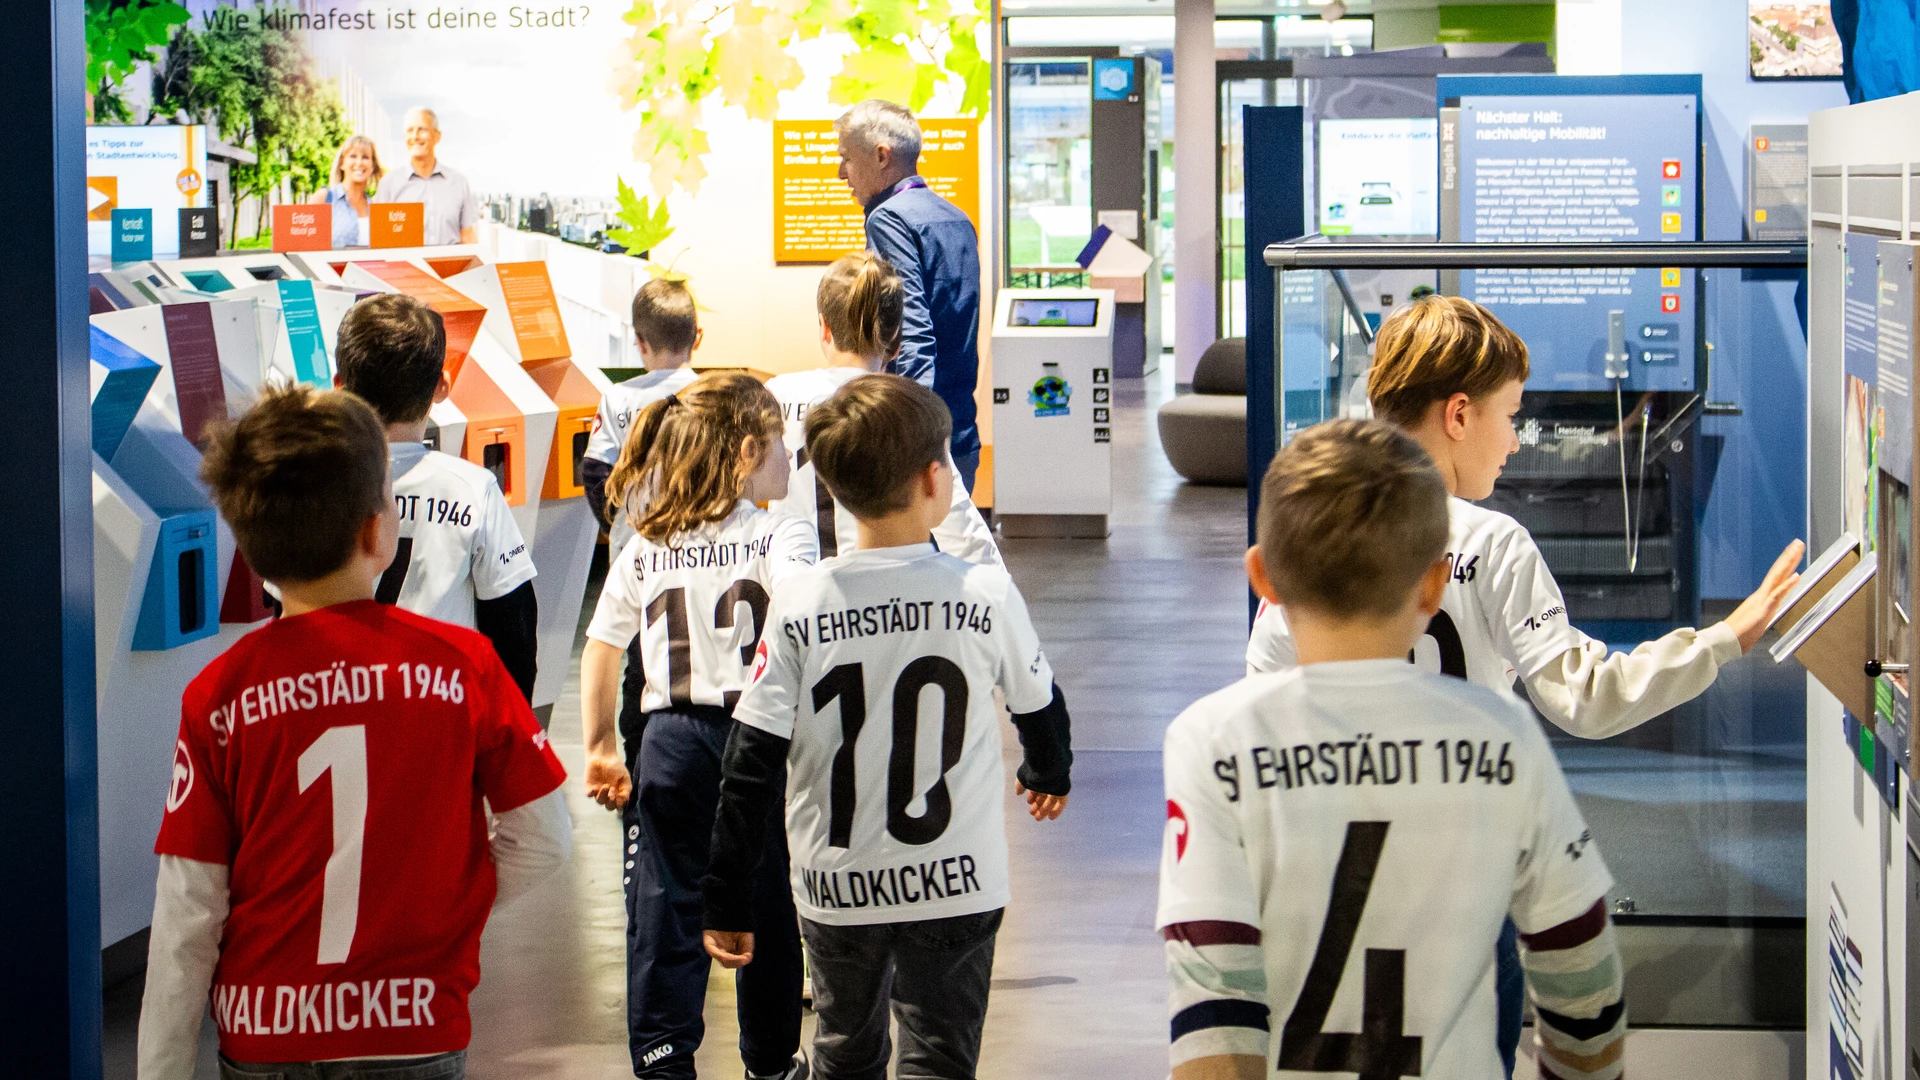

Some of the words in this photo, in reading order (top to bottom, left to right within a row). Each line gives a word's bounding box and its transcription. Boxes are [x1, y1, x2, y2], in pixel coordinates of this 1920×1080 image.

[202, 9, 249, 31] Wie
[260, 7, 376, 31] klimafest
[386, 8, 417, 29] ist
[427, 7, 497, 28] deine
[509, 5, 590, 28] Stadt?
[1476, 110, 1531, 124] Nächster
[1533, 110, 1563, 123] Halt:
[102, 139, 127, 149] Tipps
[784, 131, 801, 140] Wie
[803, 130, 818, 139] wir
[941, 129, 967, 139] Klima
[942, 142, 965, 151] auch
[1476, 127, 1547, 142] nachhaltige
[1549, 126, 1607, 140] Mobilität!
[784, 155, 818, 164] Einfluss
[1444, 144, 1456, 190] English
[291, 212, 315, 227] Erdgas
[388, 210, 406, 222] Kohle
[427, 497, 472, 526] 1946
[634, 553, 647, 581] SV
[652, 541, 739, 573] EHRSTÄDT
[784, 617, 810, 651] SV
[817, 597, 934, 644] EHRSTÄDT
[941, 601, 992, 635] 1946
[209, 699, 236, 747] SV
[241, 661, 388, 726] EHRSTÄDT
[398, 662, 464, 704] 1946
[811, 655, 969, 850] 10
[1252, 733, 1424, 790] EHRSTÄDT
[1434, 739, 1515, 786] 1946
[297, 724, 368, 965] 1
[801, 854, 981, 909] WALDKICKER
[1277, 821, 1422, 1080] 4
[212, 977, 436, 1036] WALDKICKER
[642, 1044, 673, 1067] JAKO
